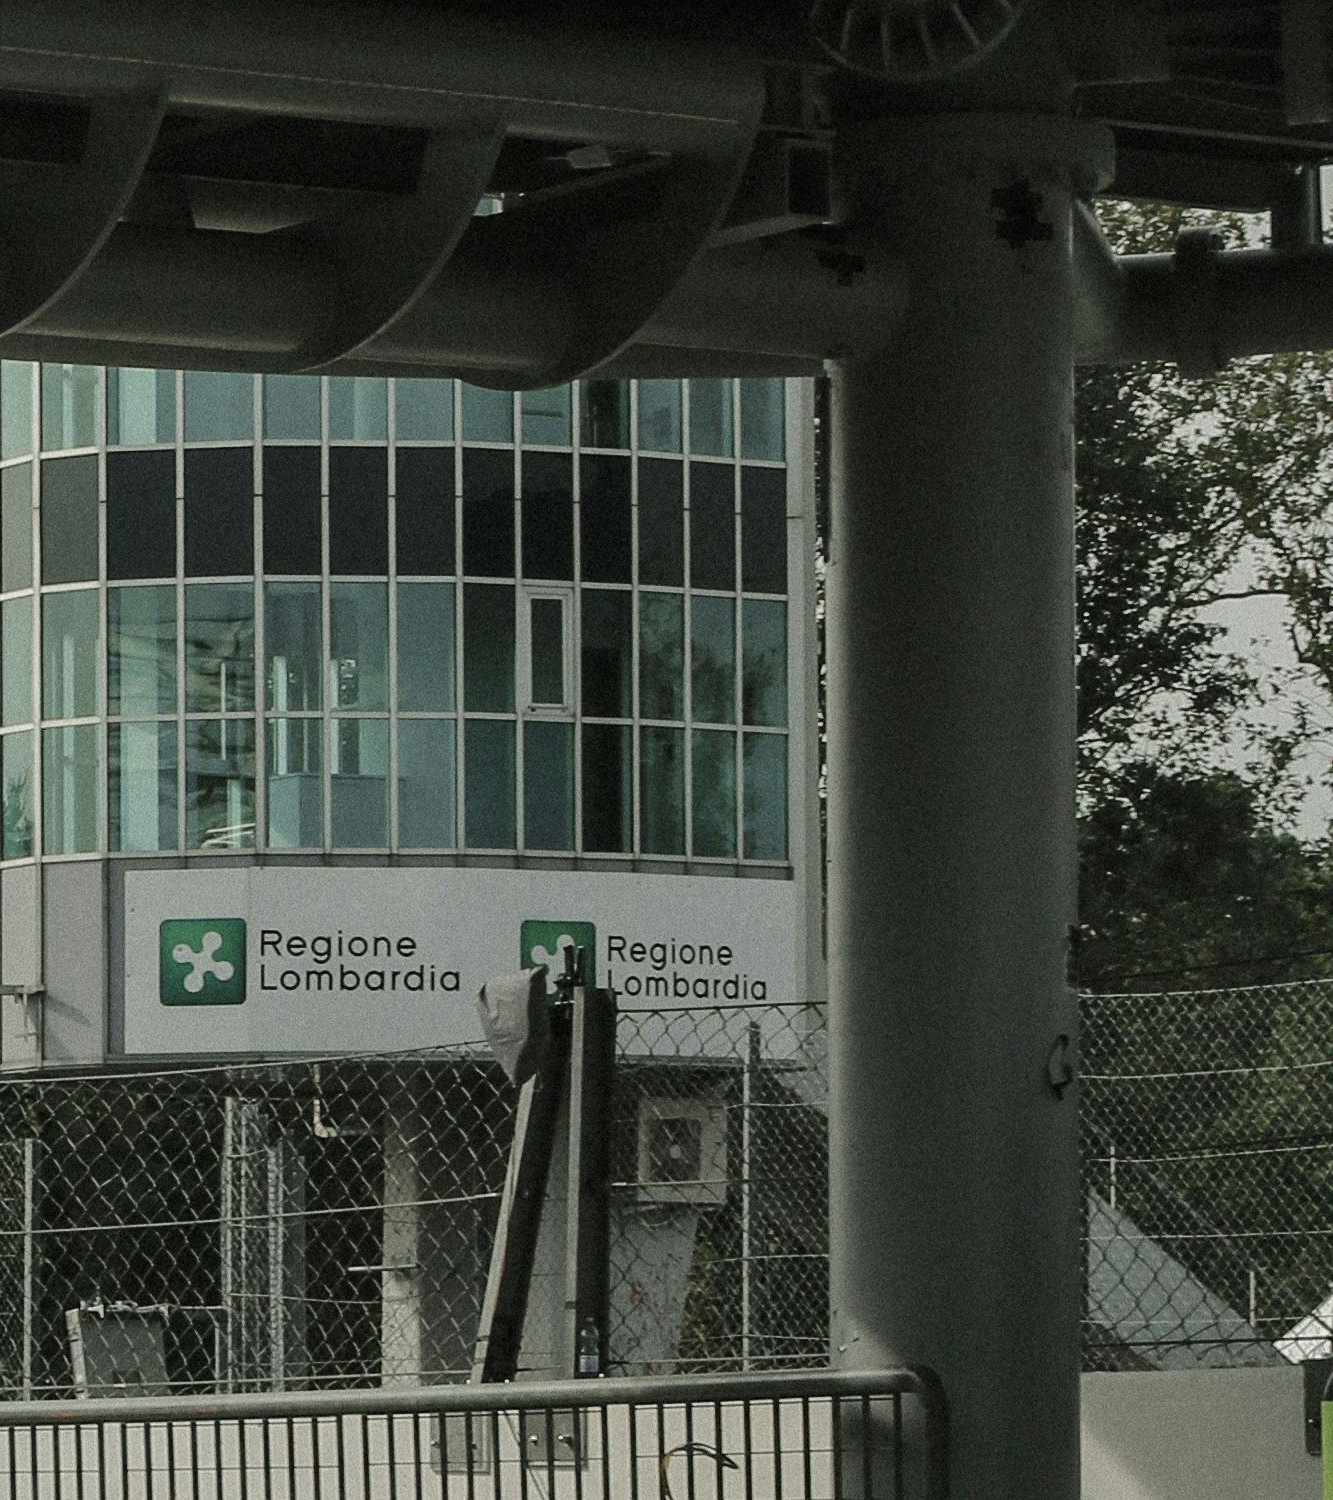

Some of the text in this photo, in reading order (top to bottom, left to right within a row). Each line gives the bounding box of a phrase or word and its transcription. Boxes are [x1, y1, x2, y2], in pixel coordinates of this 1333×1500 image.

[261, 929, 417, 963] Regione
[608, 935, 733, 971] Regione
[260, 964, 461, 992] Lombardia
[608, 969, 767, 1001] Lombardia
